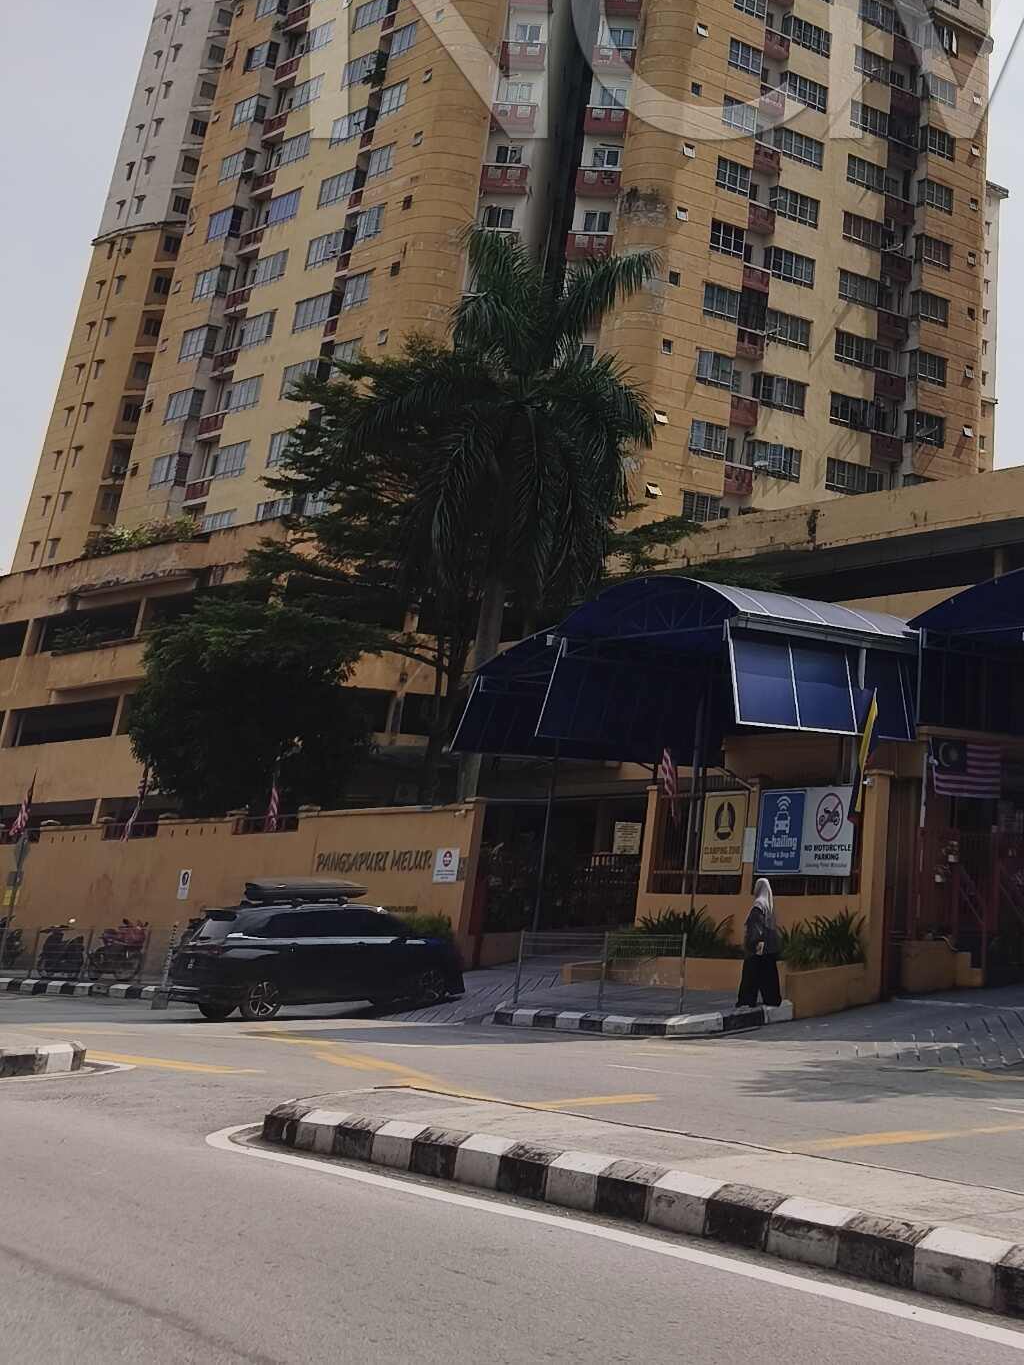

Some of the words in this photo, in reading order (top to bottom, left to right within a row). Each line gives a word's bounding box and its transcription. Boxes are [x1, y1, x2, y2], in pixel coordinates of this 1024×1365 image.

[813, 843, 852, 852] MOTORCYCLE
[315, 850, 390, 874] PANGSAPURI
[390, 849, 433, 873] MELUR
[814, 853, 839, 861] PARKING
